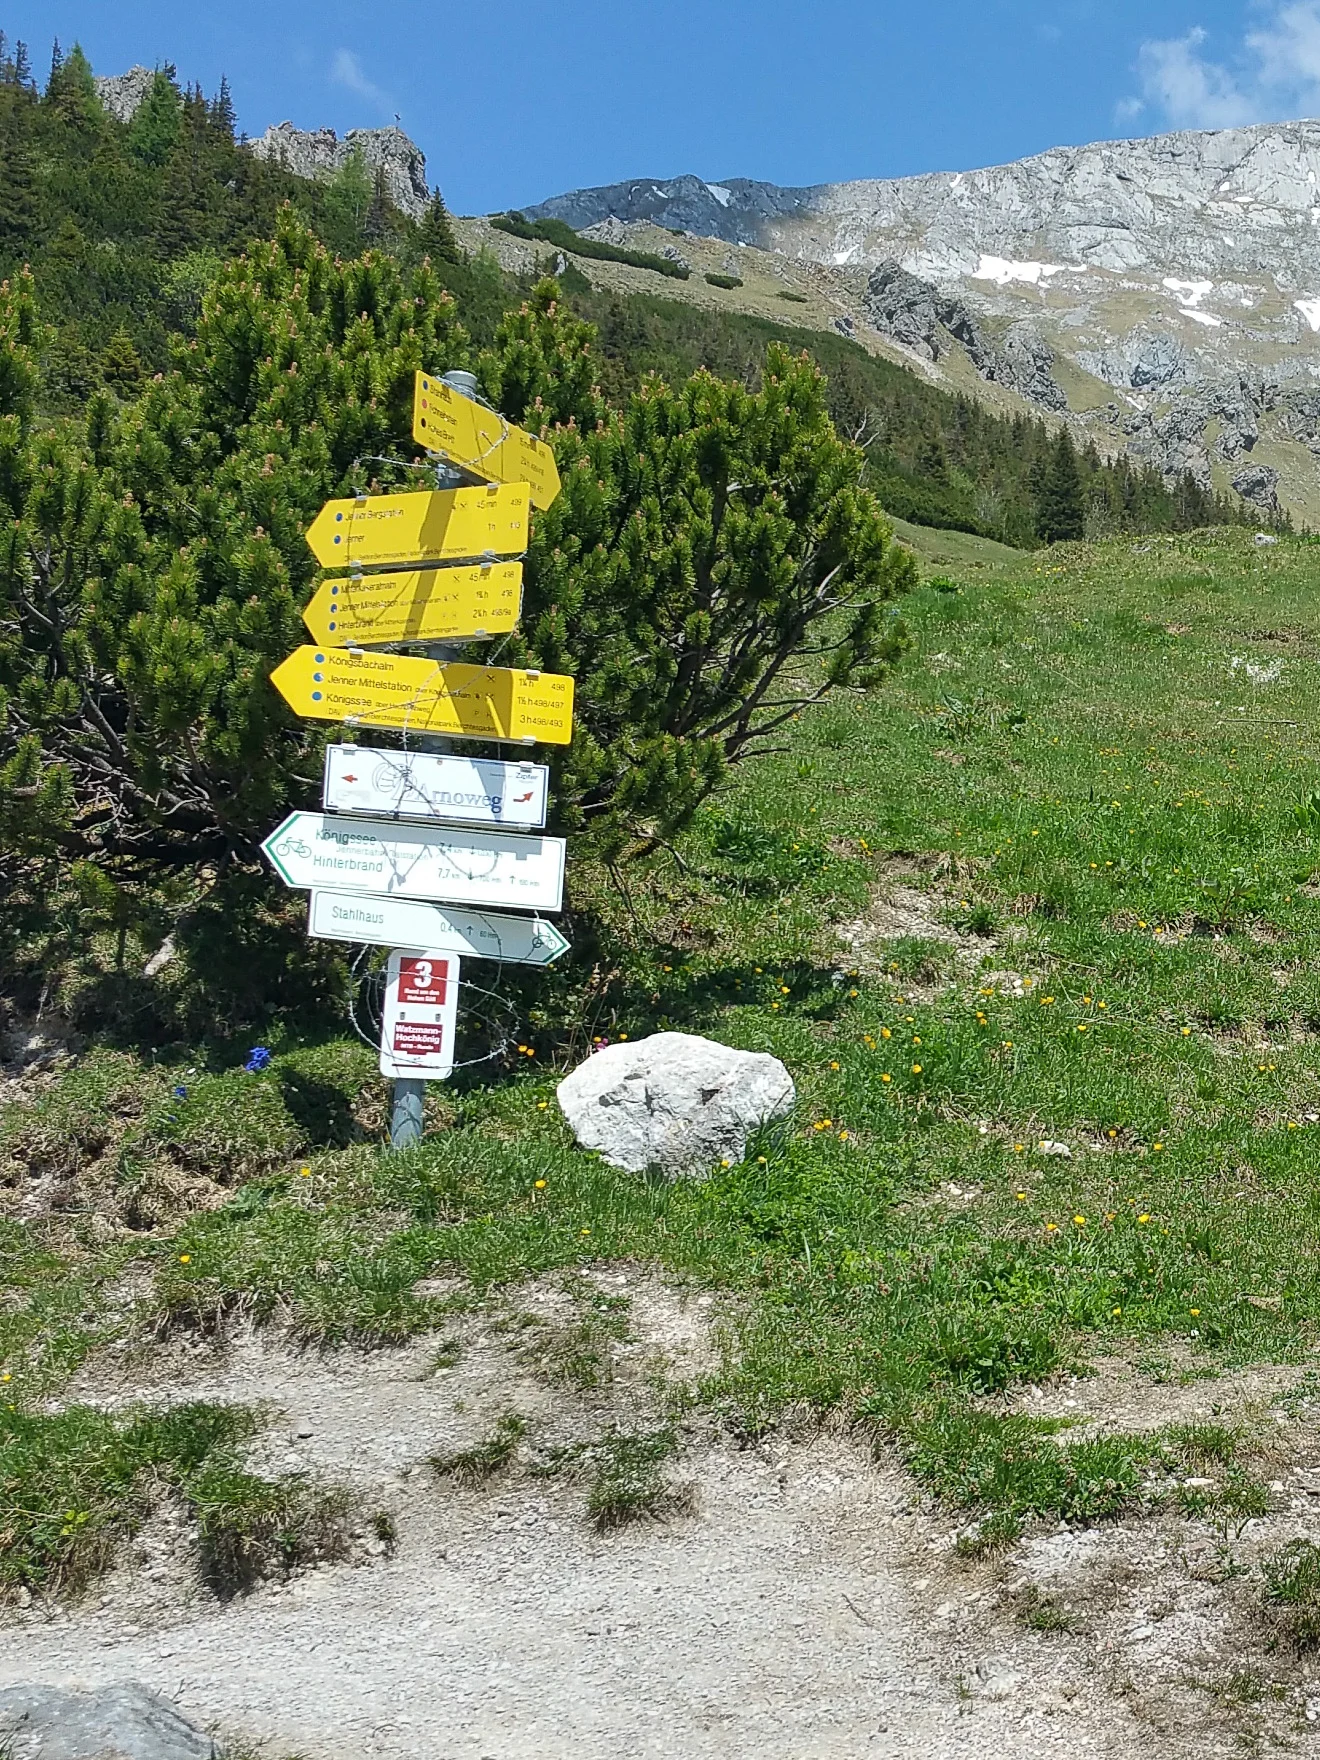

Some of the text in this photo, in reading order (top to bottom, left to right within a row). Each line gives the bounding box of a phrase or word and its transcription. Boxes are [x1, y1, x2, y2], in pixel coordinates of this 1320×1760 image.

[328, 655, 394, 671] Königsbachalm
[328, 674, 357, 687] Jenner
[358, 677, 412, 692] Mittelstation
[551, 683, 565, 692] 498
[326, 693, 372, 707] Königssee
[533, 698, 564, 709] 498/497
[315, 828, 377, 846] Königssee
[313, 854, 383, 873] Hinterbrand
[331, 905, 384, 924] Stahlhaus
[414, 961, 432, 987] 3
[395, 1024, 442, 1035] Watzmann-
[396, 1033, 440, 1045] Hochkönig
